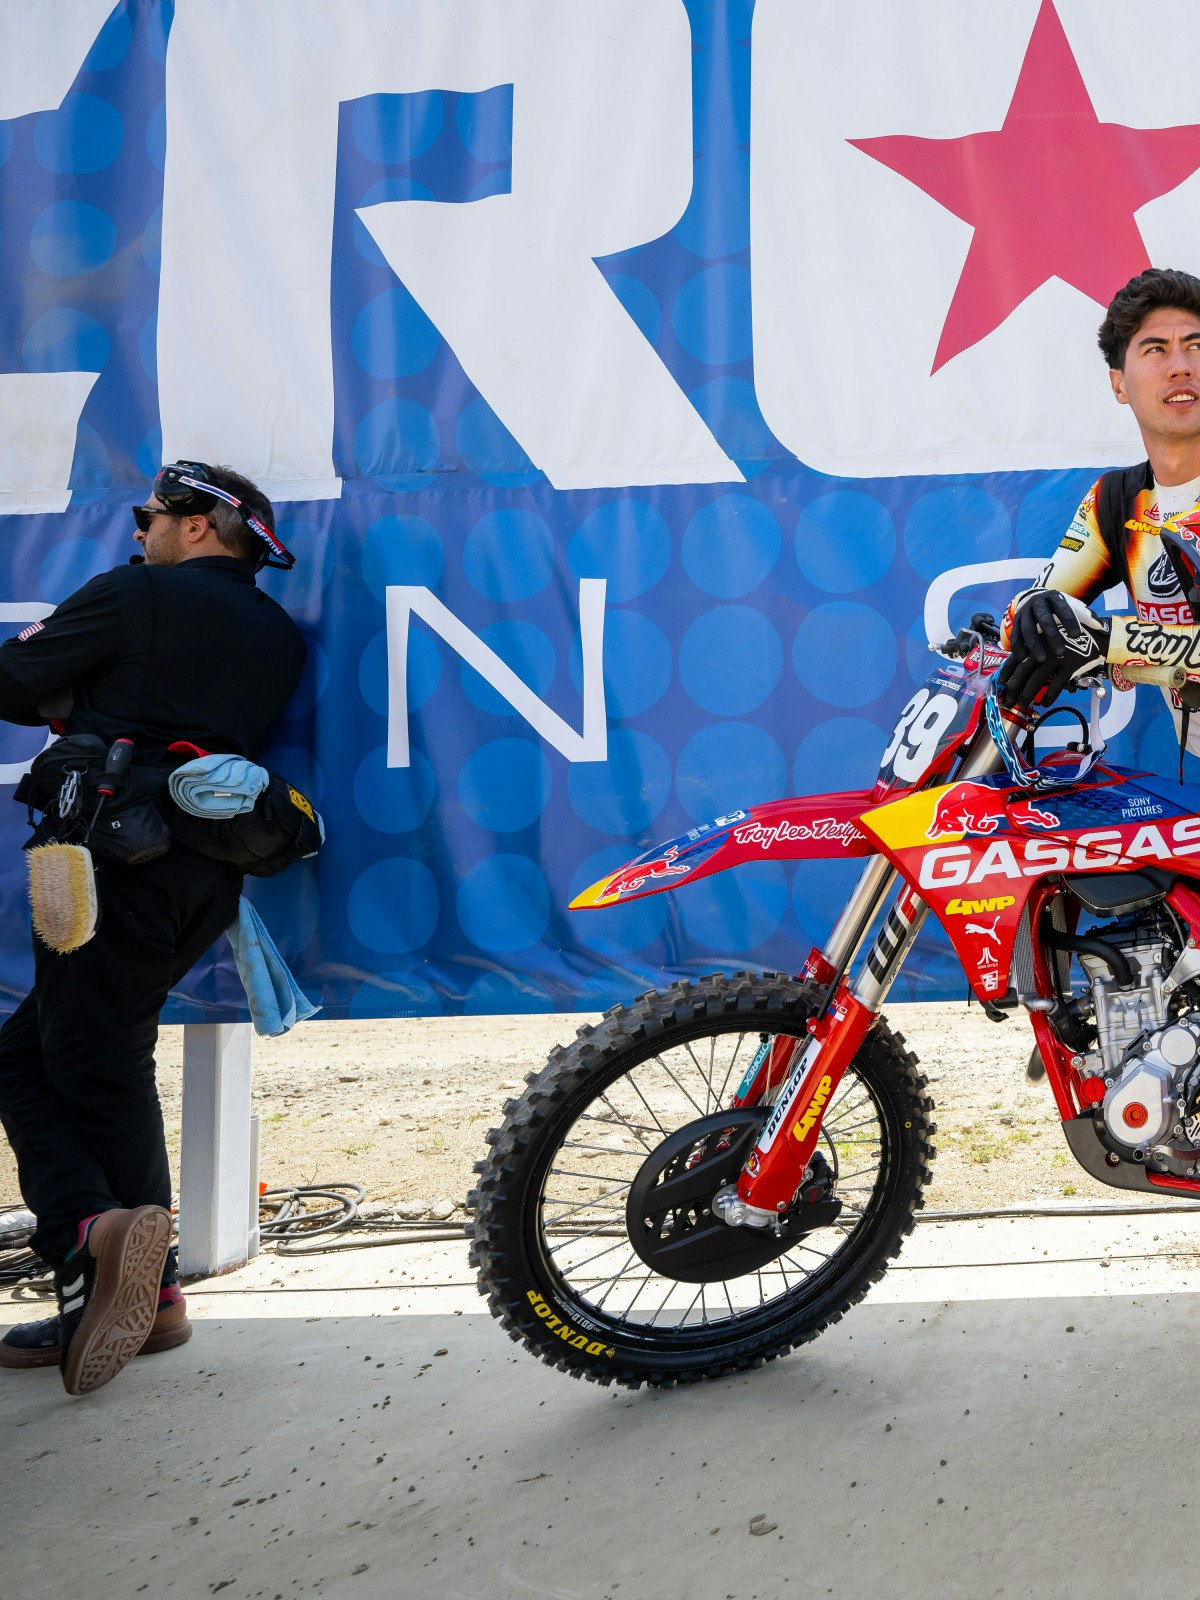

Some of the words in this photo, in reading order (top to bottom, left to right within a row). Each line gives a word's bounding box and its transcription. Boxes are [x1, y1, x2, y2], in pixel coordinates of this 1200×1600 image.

[247, 518, 282, 555] GRIFFITH
[880, 688, 958, 783] 39
[1122, 805, 1163, 818] PICTURES
[1128, 797, 1151, 807] SONY
[734, 821, 777, 850] Troy
[775, 820, 812, 841] Lee
[945, 895, 1016, 916] 4WP
[767, 1057, 808, 1139] DUNLOP
[792, 1074, 832, 1142] 4WP
[526, 1289, 607, 1356] DUNLOP
